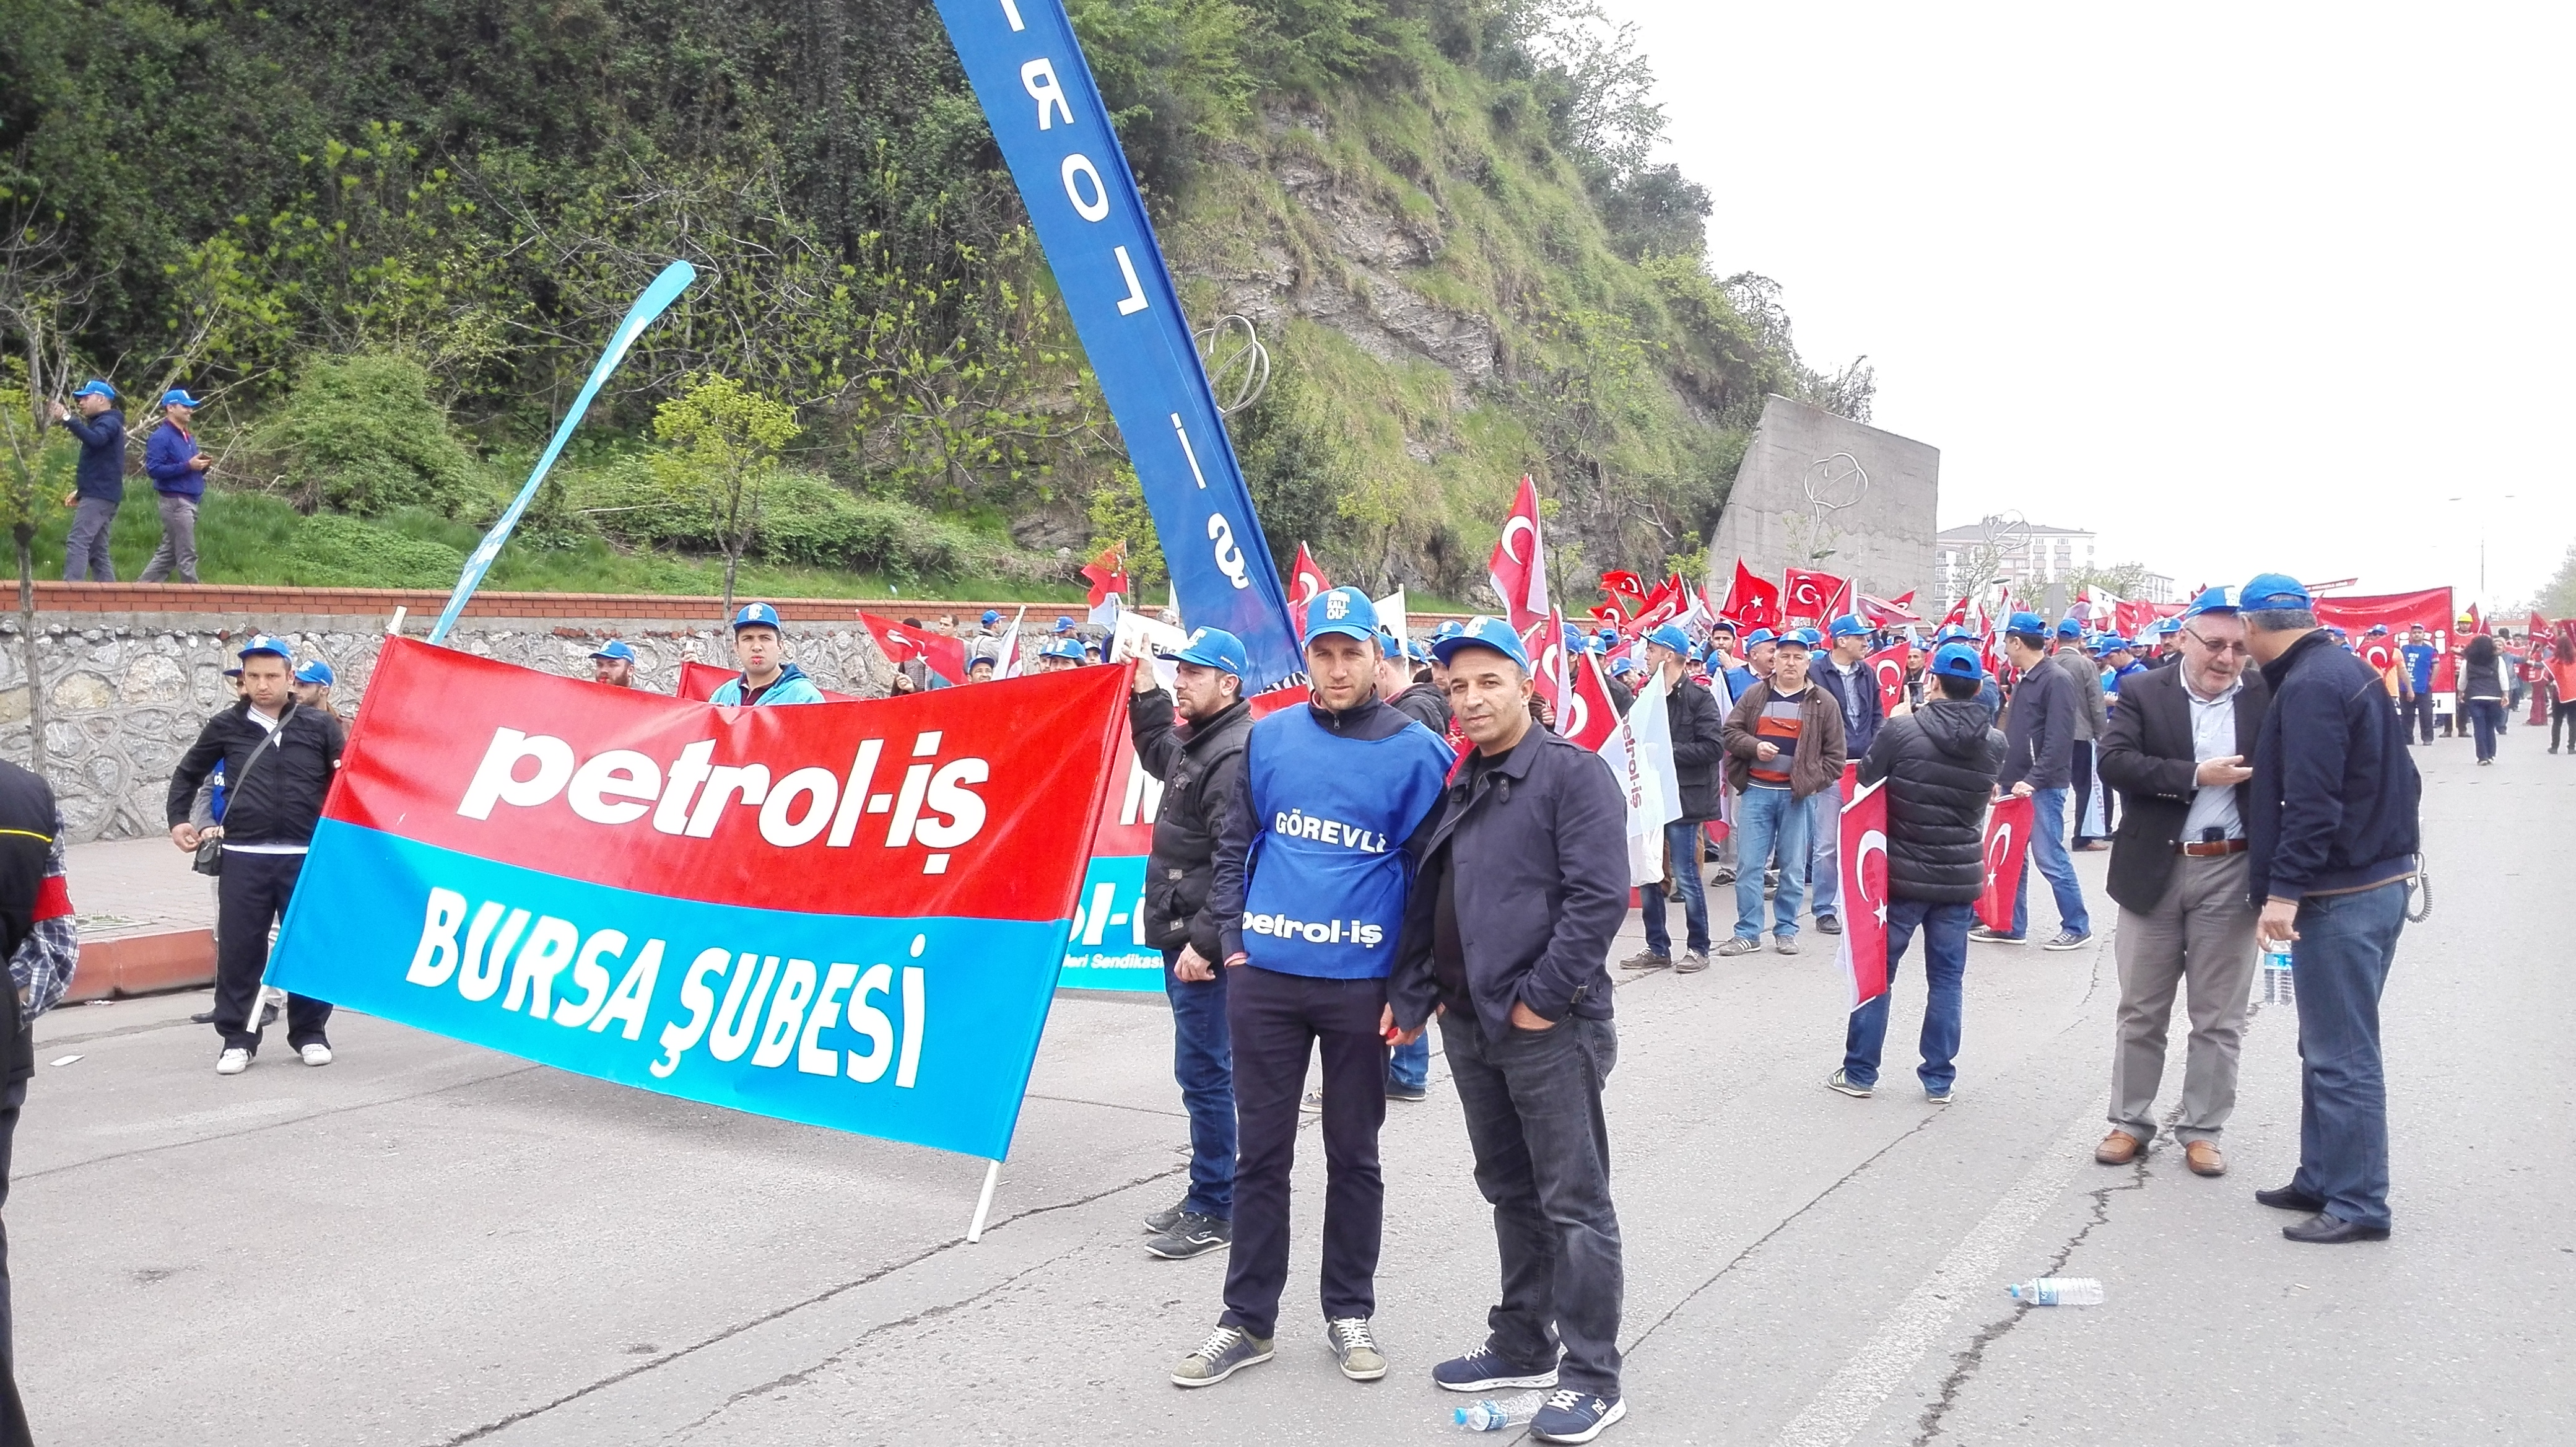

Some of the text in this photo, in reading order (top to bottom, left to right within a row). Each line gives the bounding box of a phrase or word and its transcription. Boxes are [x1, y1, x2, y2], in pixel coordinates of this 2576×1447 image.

[456, 725, 990, 875] petrol-iş
[1276, 808, 1386, 853] GÖREVLİ
[406, 887, 926, 1088] BURSA ŞUBESİ
